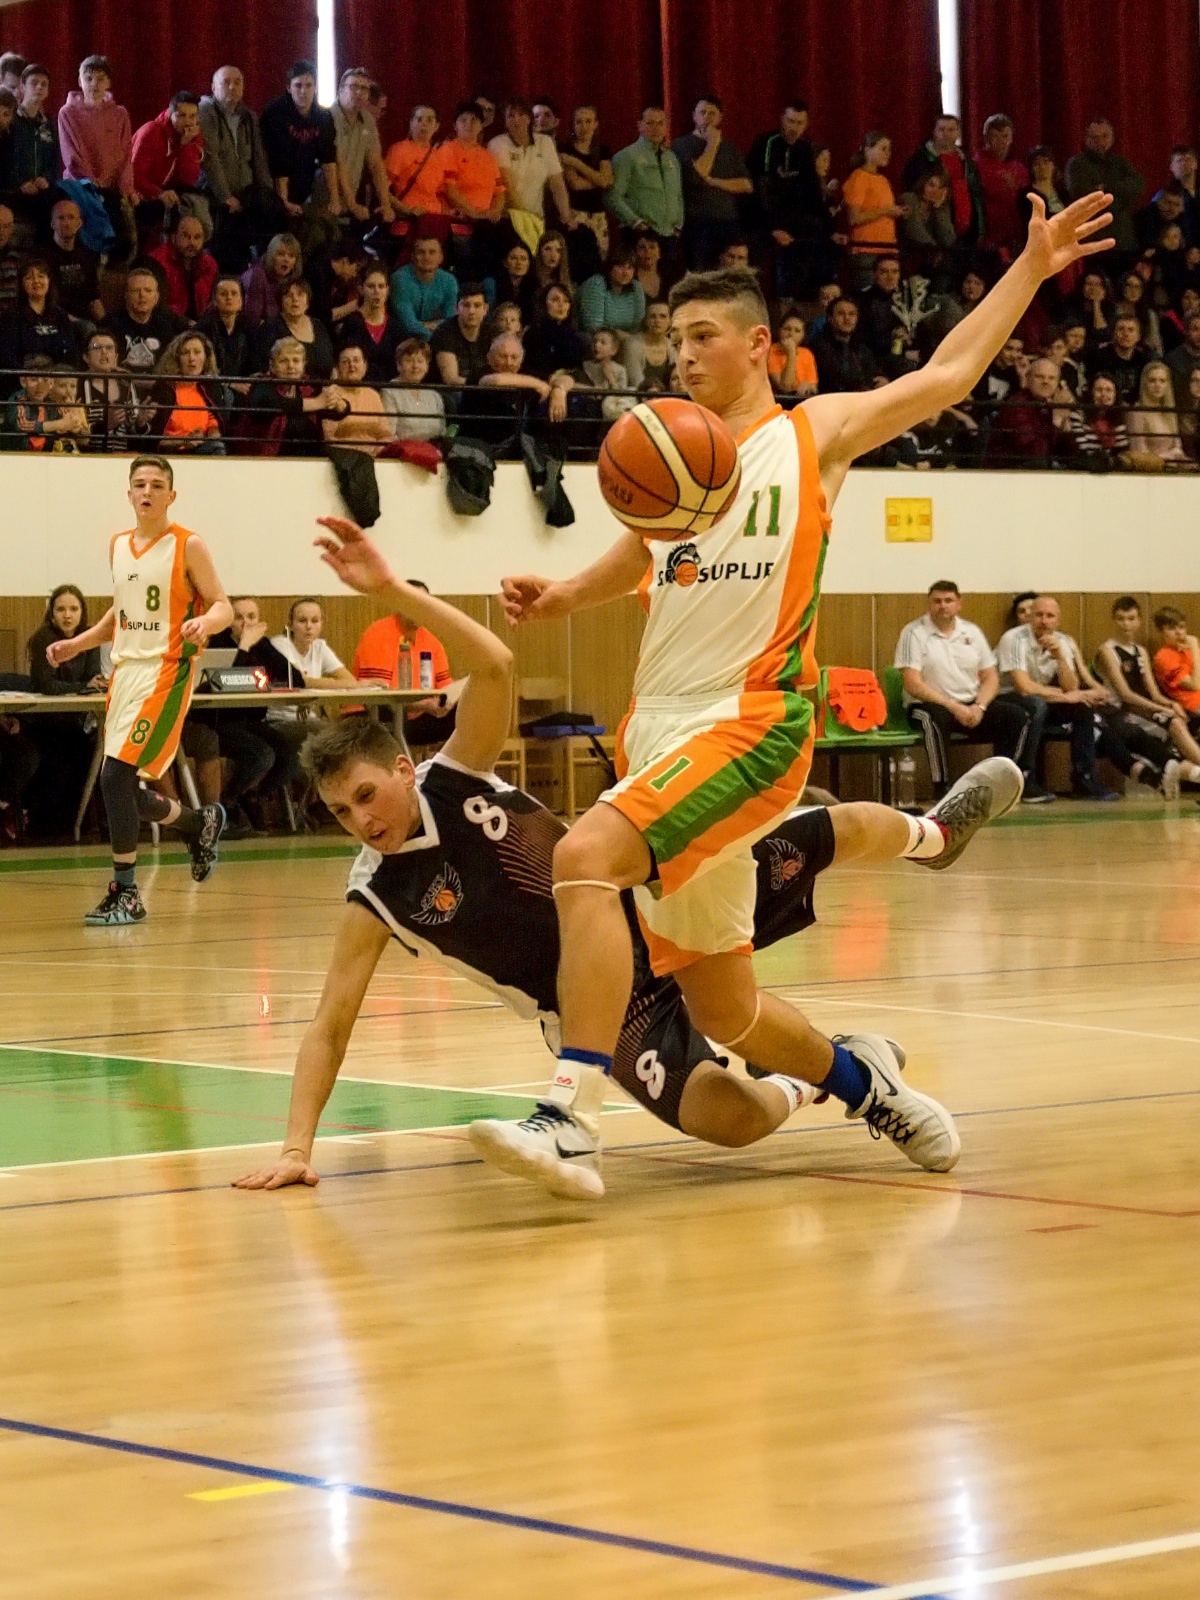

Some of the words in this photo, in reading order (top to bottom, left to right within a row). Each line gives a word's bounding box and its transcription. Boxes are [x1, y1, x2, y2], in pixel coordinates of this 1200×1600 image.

[743, 485, 781, 537] 11
[146, 585, 160, 612] 8
[130, 718, 151, 745] 8
[463, 795, 508, 841] 8
